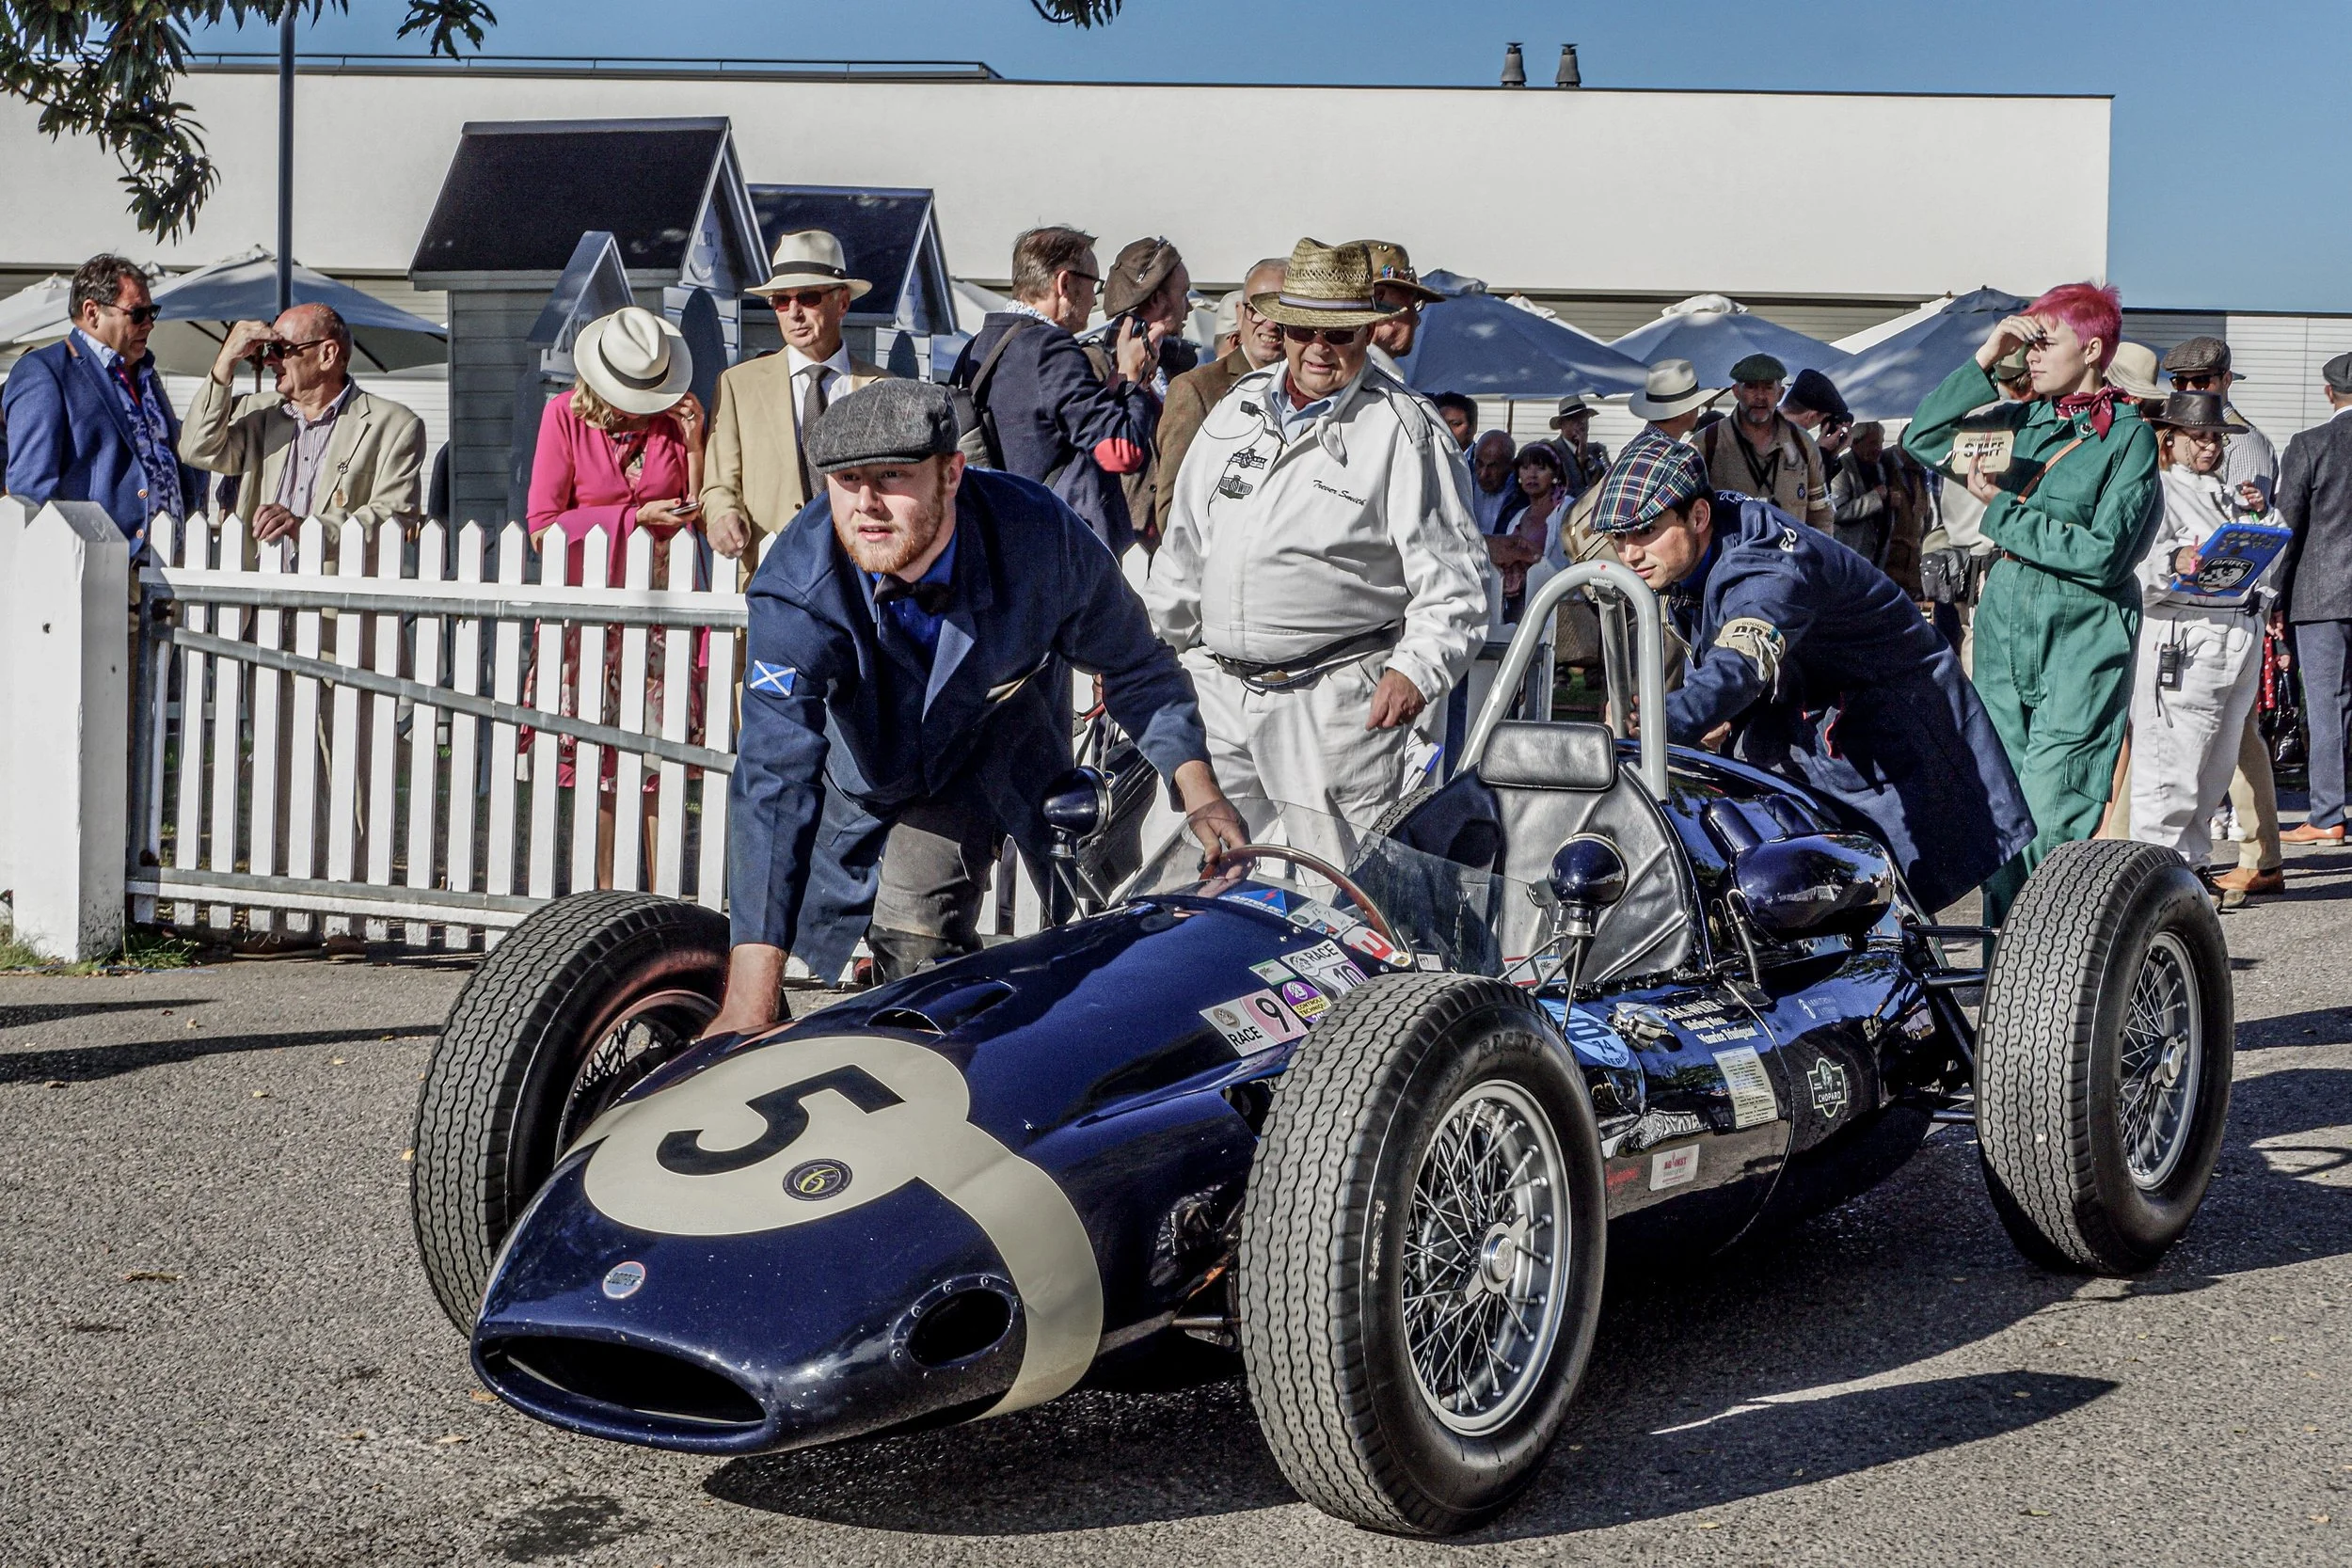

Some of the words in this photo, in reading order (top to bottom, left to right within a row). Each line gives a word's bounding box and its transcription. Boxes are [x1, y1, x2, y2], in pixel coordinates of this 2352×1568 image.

[1338, 490, 1367, 506] Smith
[1304, 942, 1339, 962] RACE
[1255, 997, 1291, 1034] 9
[1227, 1025, 1263, 1047] RACE
[1818, 1090, 1842, 1103] CHOPARD
[656, 1063, 907, 1176] 5
[800, 1168, 840, 1194] 6
